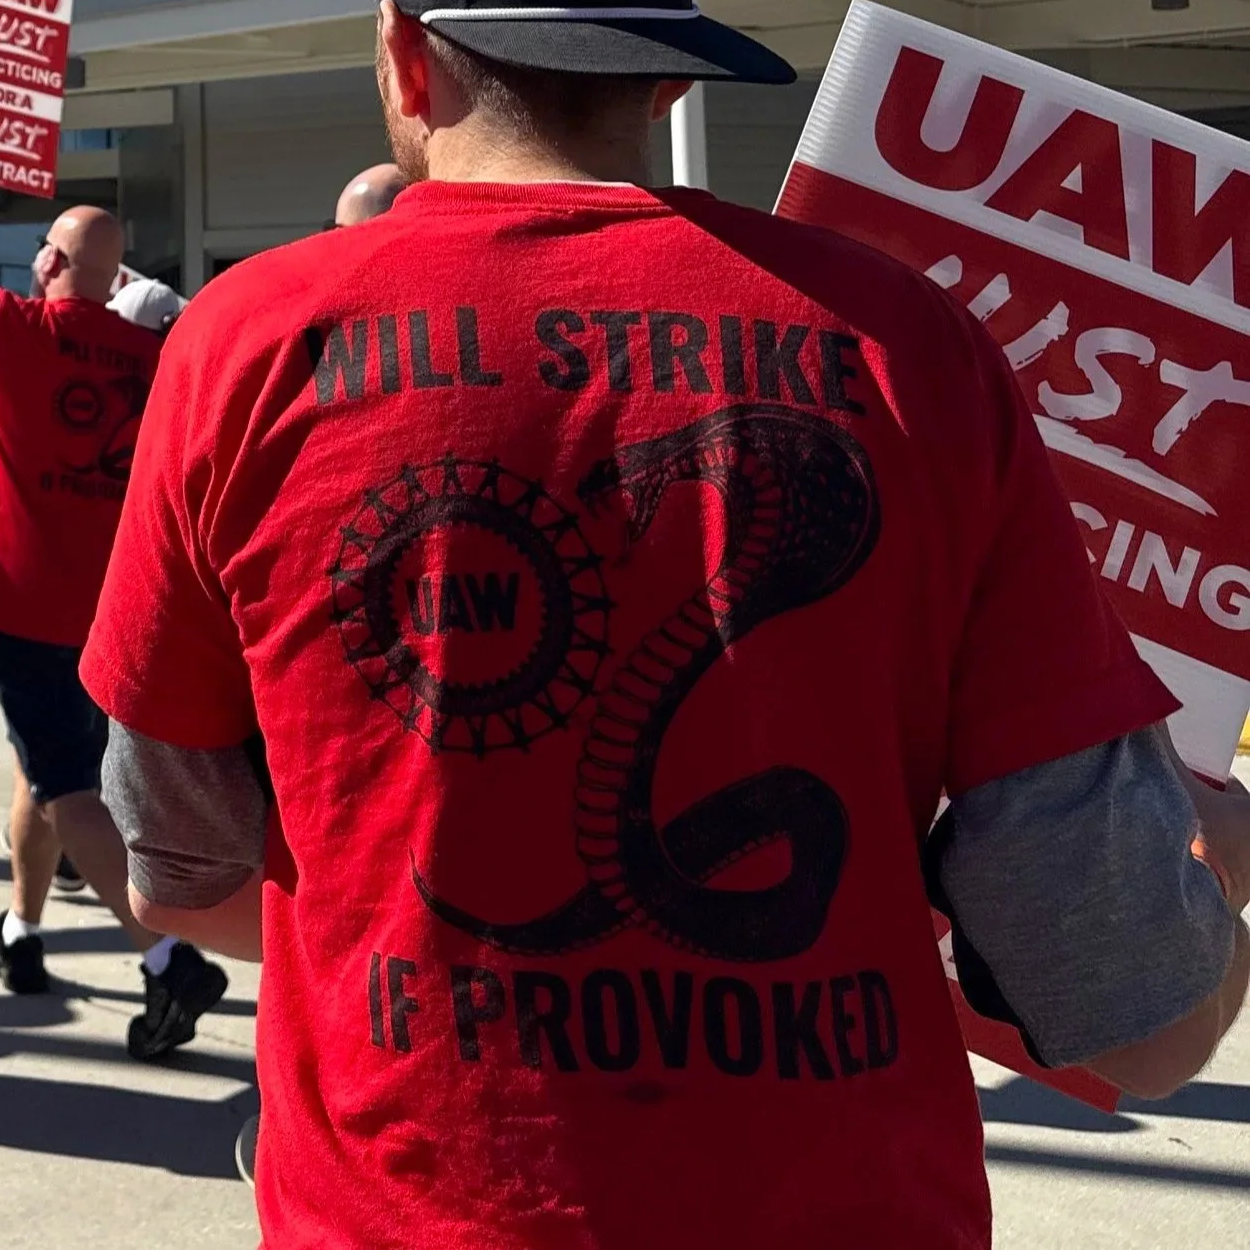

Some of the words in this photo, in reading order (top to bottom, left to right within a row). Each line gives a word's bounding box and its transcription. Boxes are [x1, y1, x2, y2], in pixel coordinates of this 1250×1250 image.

[17, 94, 34, 110] A
[303, 306, 503, 406] WILL
[535, 307, 868, 416] STRIKE
[404, 572, 520, 635] UAW
[368, 951, 421, 1055] IF
[452, 963, 899, 1081] PROVOKED
